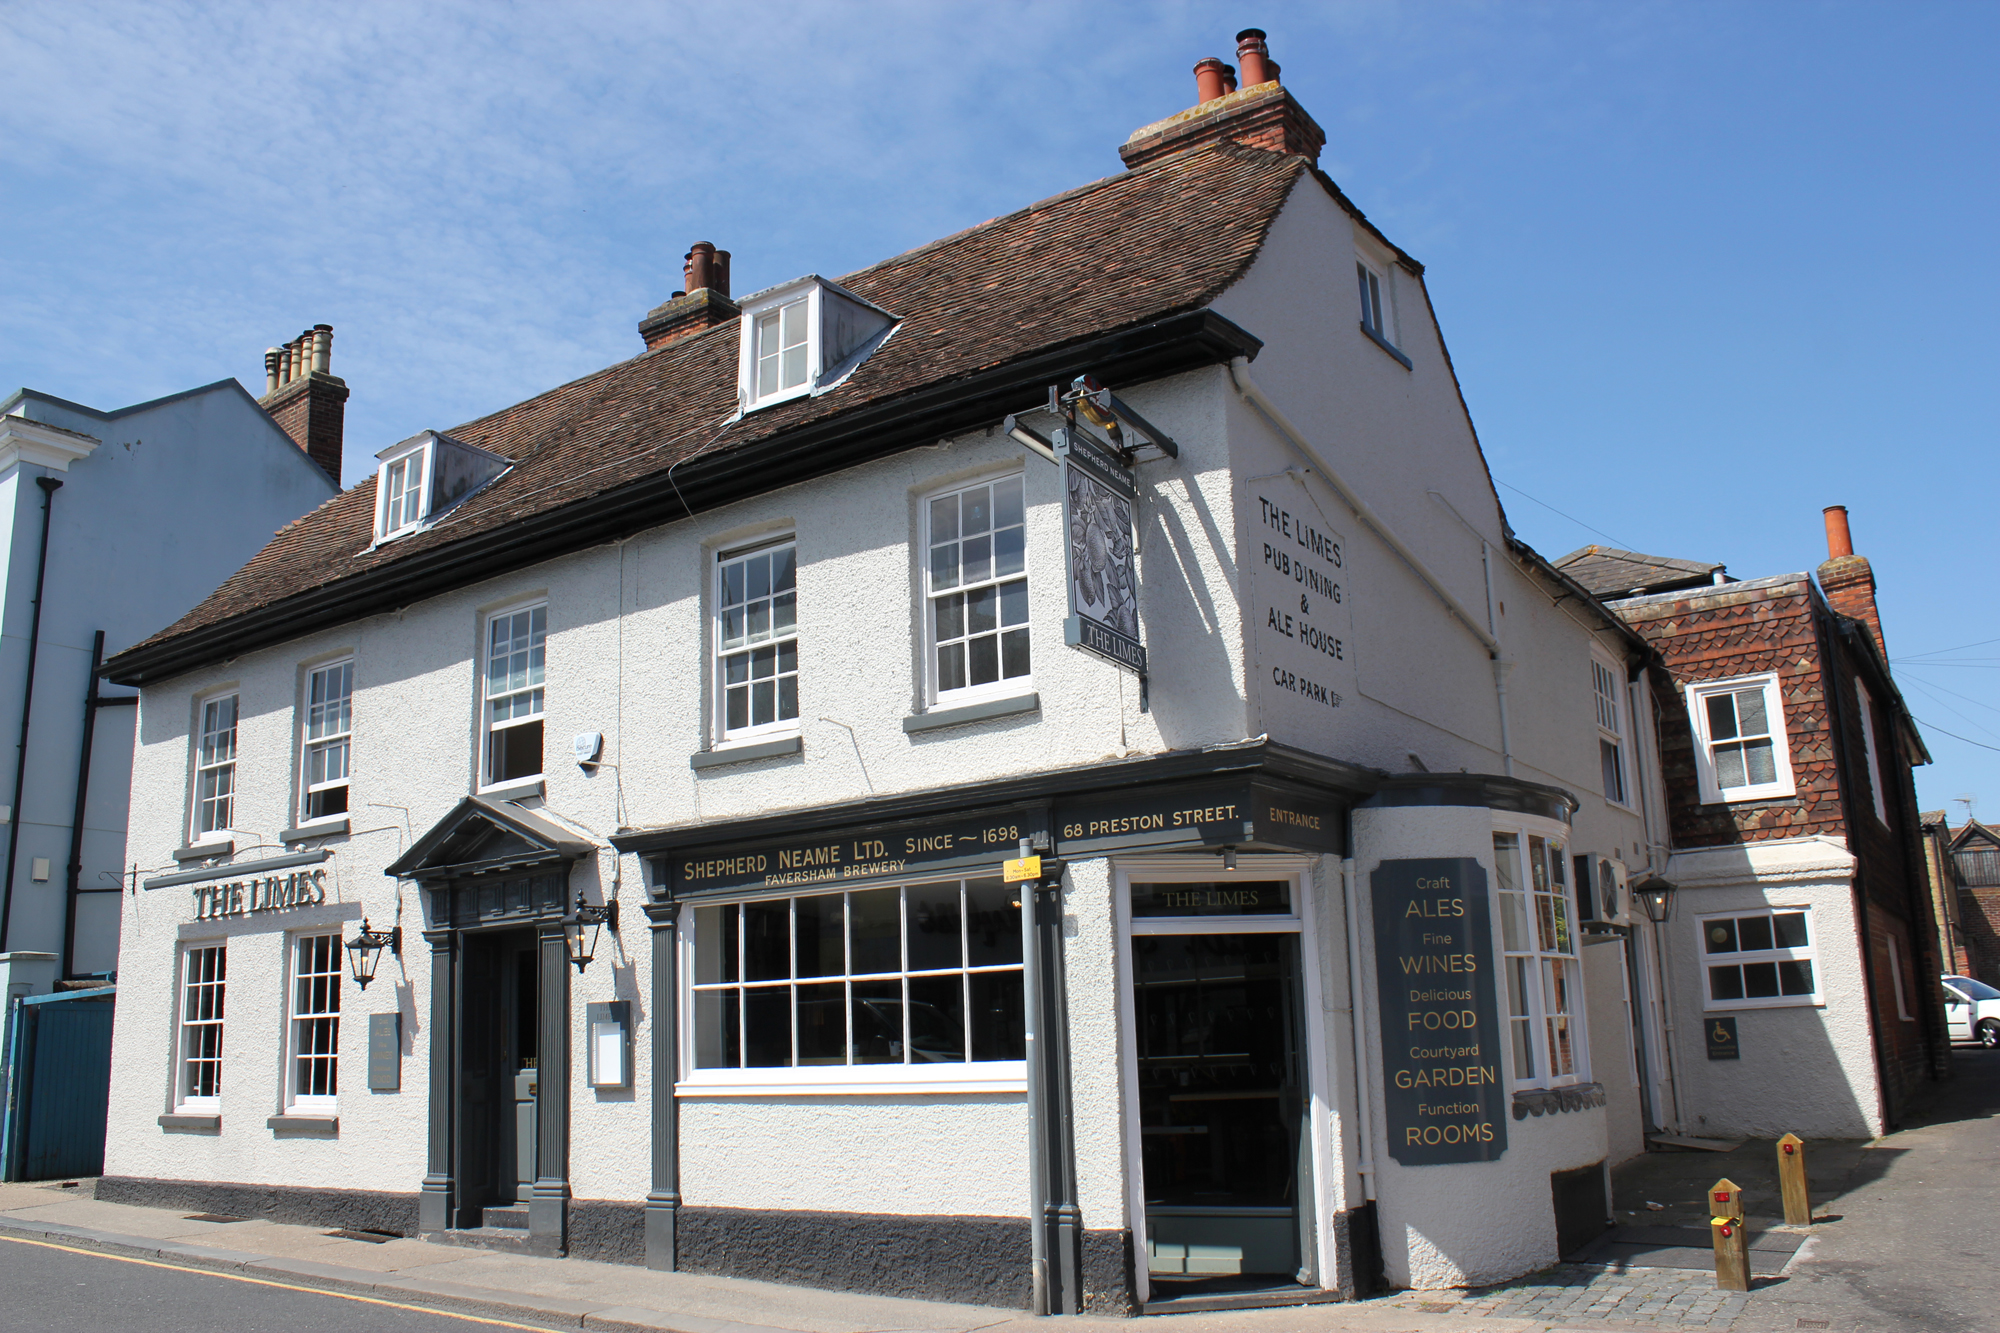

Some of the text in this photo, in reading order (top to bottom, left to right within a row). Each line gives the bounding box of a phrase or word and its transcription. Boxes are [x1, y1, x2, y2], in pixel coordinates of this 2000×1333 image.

[1073, 442, 1131, 488] SHEPHERD NEAME
[1258, 495, 1342, 569] THE LIMES
[1263, 542, 1342, 604] PUB DINING
[1300, 593, 1310, 615] &
[1267, 607, 1344, 661] ALE HOUSE
[1086, 624, 1143, 667] THE LIMES
[1272, 666, 1329, 705] CAR PARK
[1063, 805, 1240, 838] 68 PRESTON STREET.
[1269, 807, 1320, 830] ENTRANCE
[684, 854, 767, 881] SHEPHERD
[778, 845, 841, 868] NEAME
[853, 840, 889, 859] LTD.
[905, 834, 953, 854] SINCE
[982, 825, 1019, 844] 1698
[765, 858, 906, 887] FAVERSHAM BREWERY
[1416, 877, 1450, 890] Craft
[194, 869, 327, 919] THE LIMES
[1162, 890, 1259, 907] THE LIMES
[1405, 898, 1464, 918] ALES
[1423, 933, 1452, 945] Fine
[1399, 954, 1477, 974] WINES
[1410, 988, 1472, 1002] Delicious
[1408, 1010, 1477, 1031] FOOD
[375, 1027, 391, 1037] ALES
[373, 1051, 393, 1060] WINES
[1409, 1043, 1479, 1059] Courtyard
[373, 1074, 392, 1084] FOOD
[1395, 1065, 1496, 1089] GARDEN
[1418, 1101, 1480, 1116] Function
[1406, 1123, 1494, 1146] ROOMS
